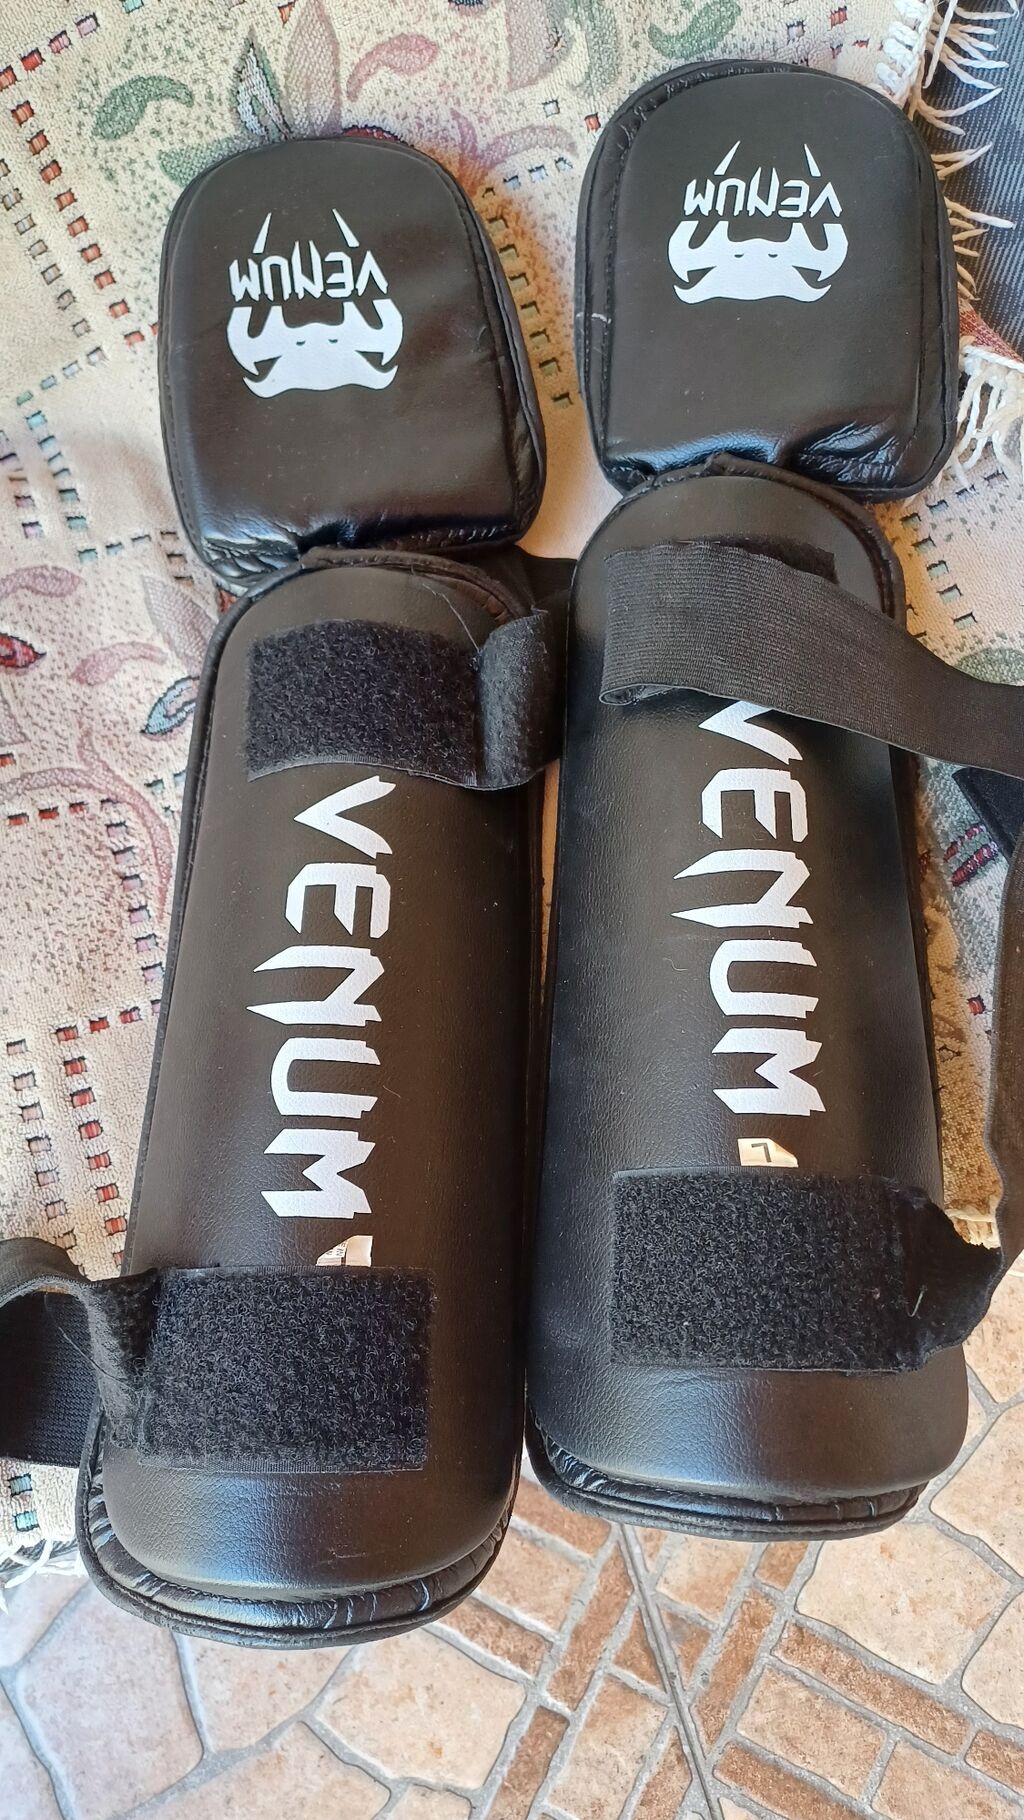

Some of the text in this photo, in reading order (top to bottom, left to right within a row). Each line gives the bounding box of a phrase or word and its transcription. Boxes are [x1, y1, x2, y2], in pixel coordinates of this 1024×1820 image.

[229, 240, 388, 302] VENUM
[684, 167, 843, 218] VENUM
[247, 776, 396, 1219] VENUM
[671, 700, 826, 1116] VENUM
